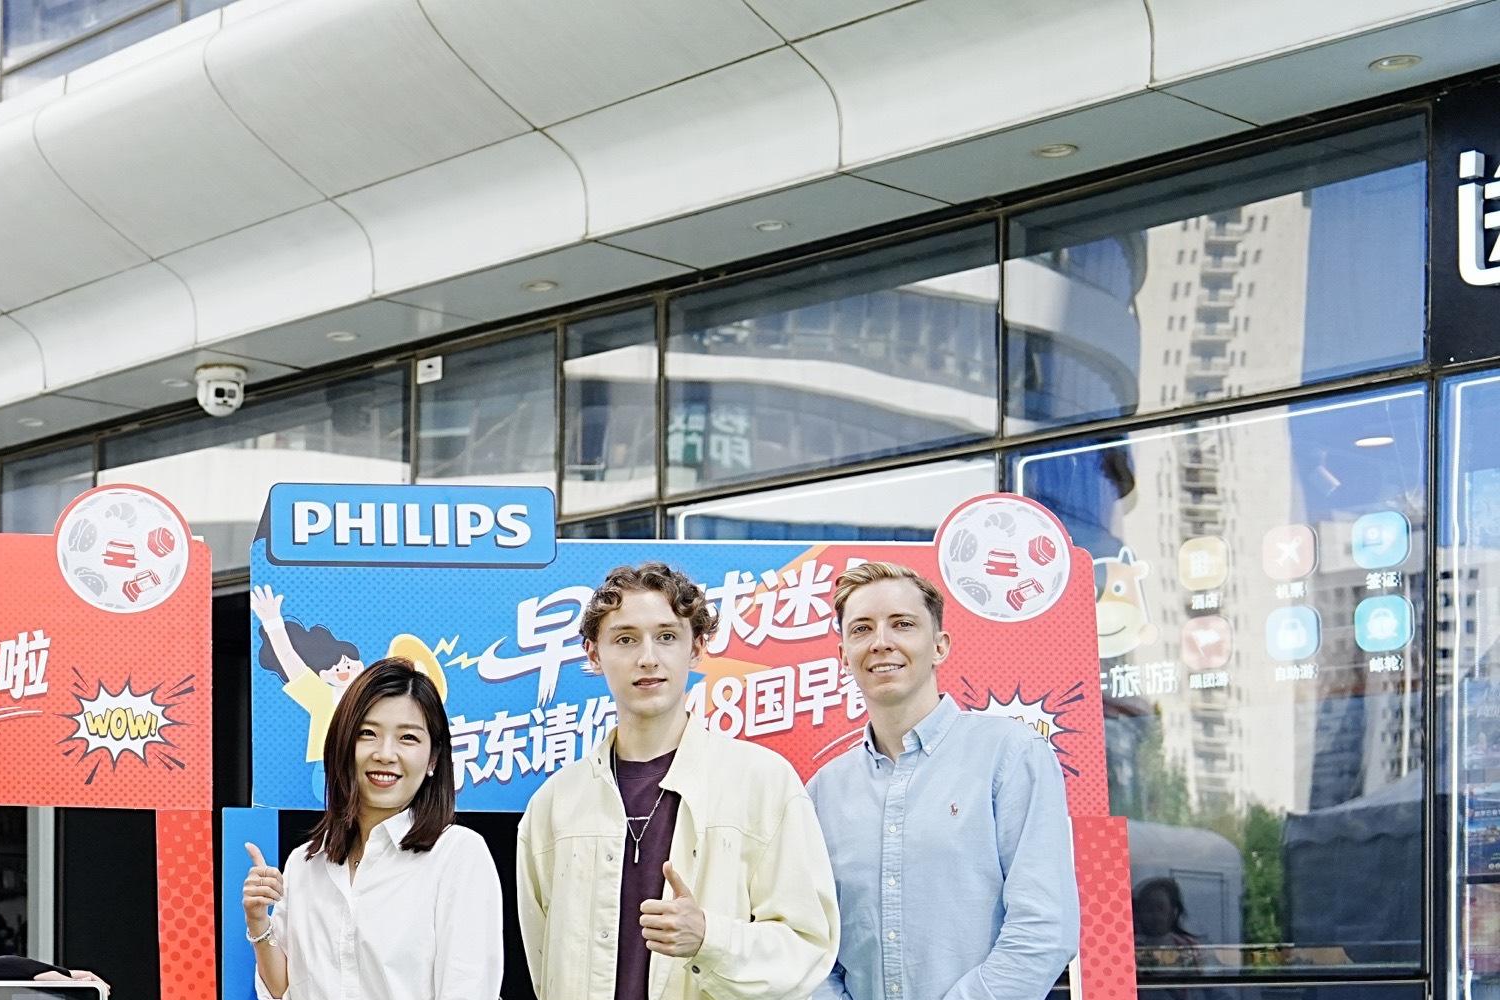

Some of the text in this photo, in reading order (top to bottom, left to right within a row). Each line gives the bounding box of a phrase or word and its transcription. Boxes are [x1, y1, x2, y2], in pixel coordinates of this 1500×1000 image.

[292, 501, 532, 548] PHILIPS
[1100, 661, 1176, 697] 旅游
[84, 707, 158, 741] WOW!
